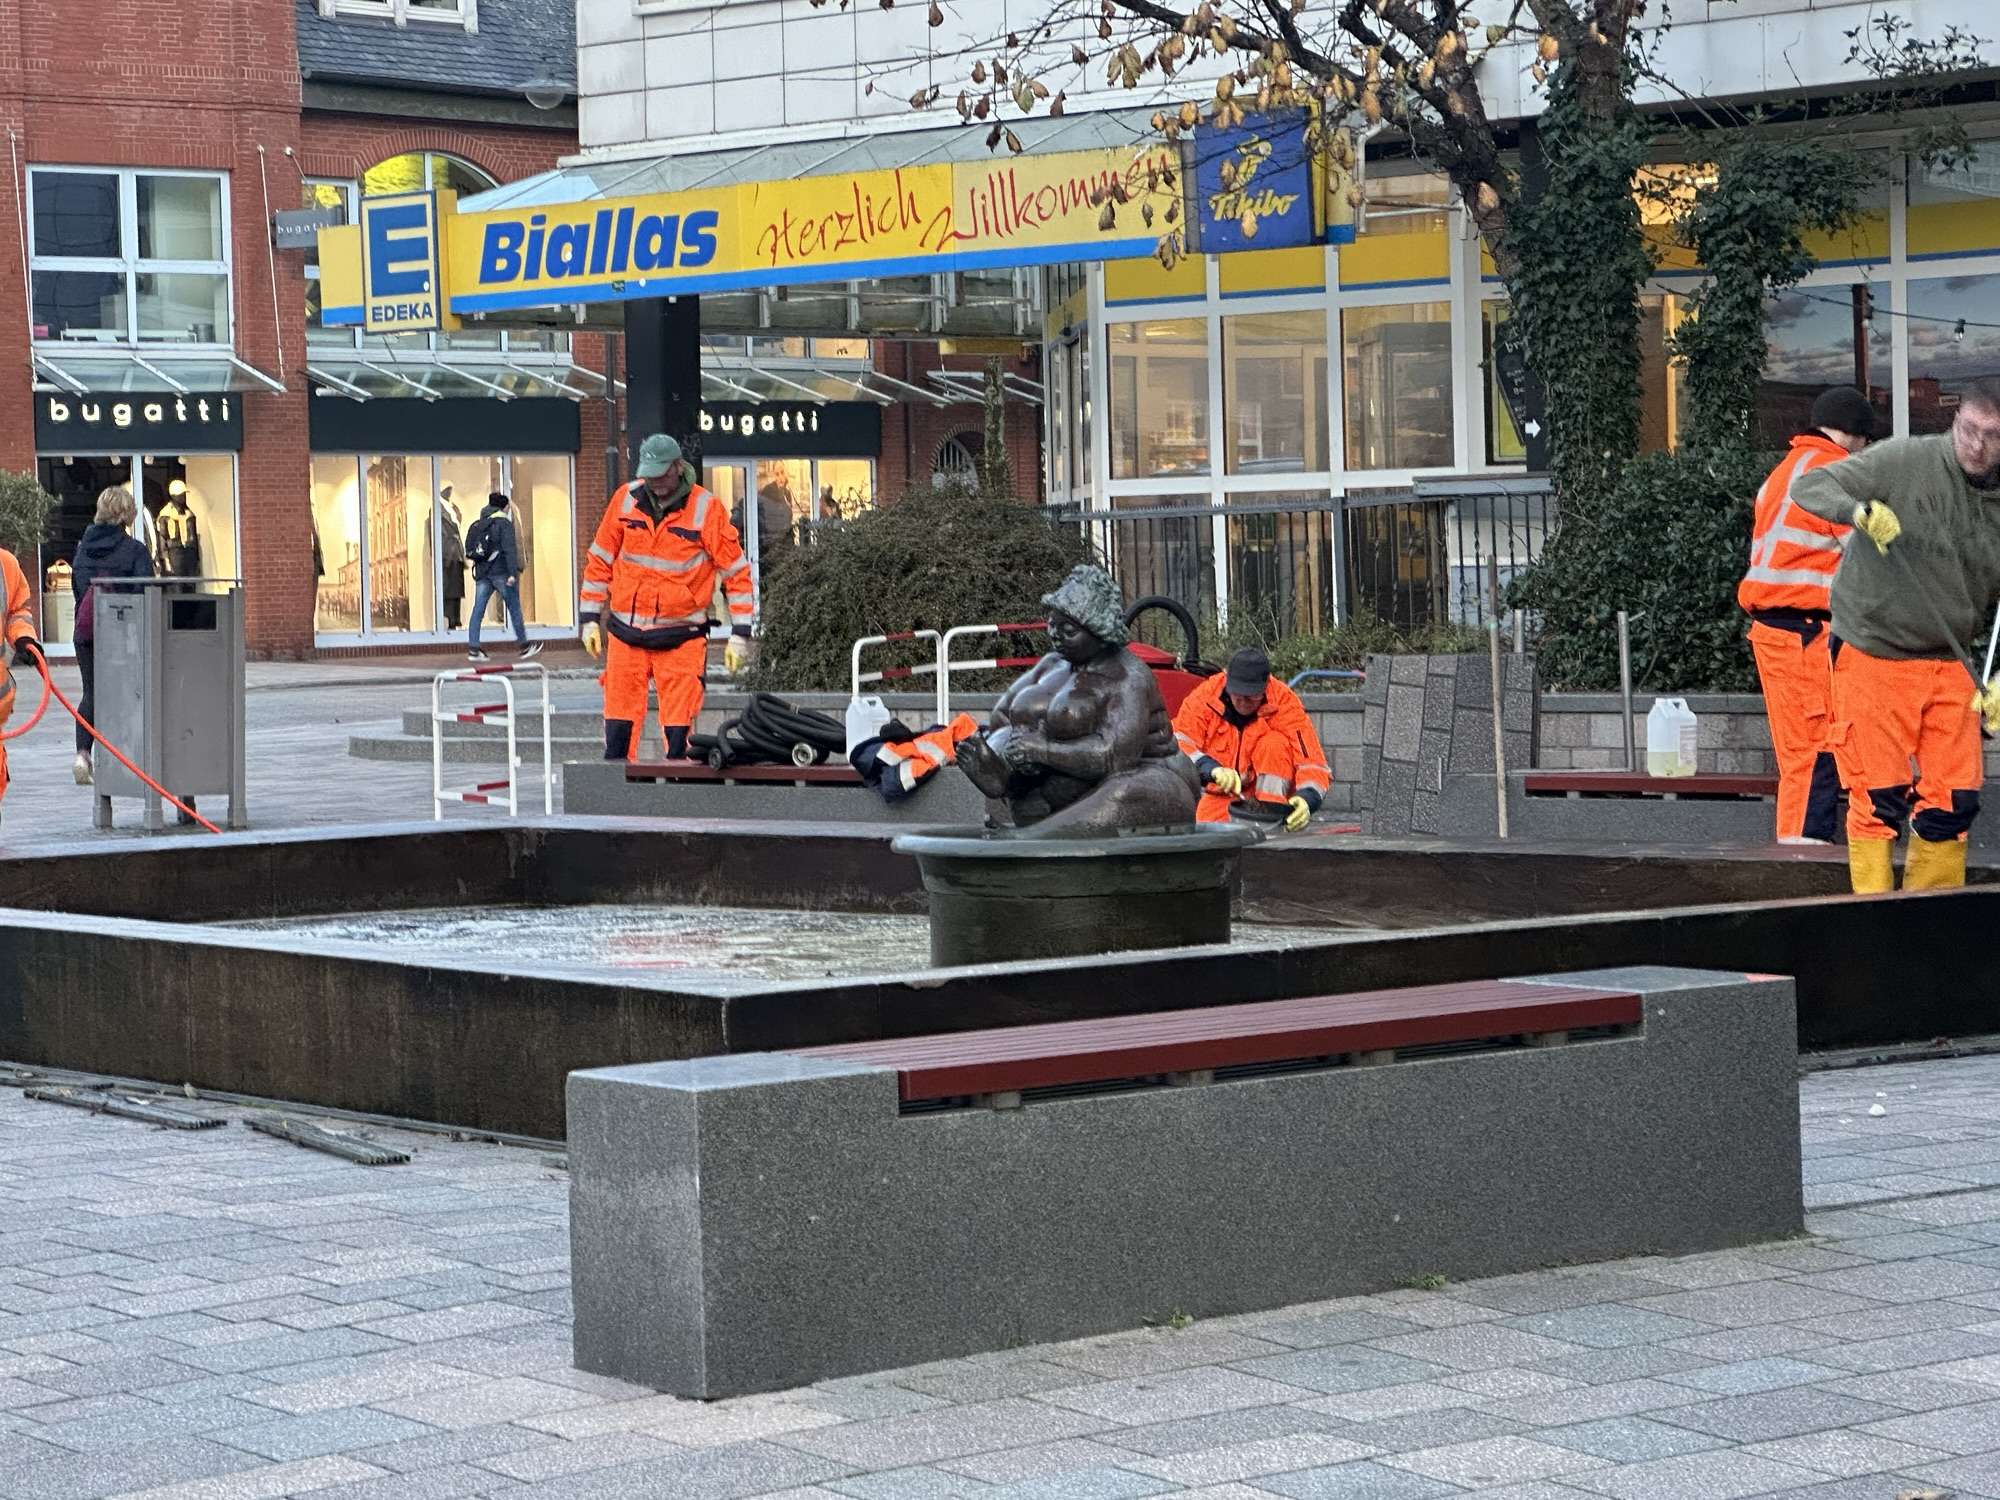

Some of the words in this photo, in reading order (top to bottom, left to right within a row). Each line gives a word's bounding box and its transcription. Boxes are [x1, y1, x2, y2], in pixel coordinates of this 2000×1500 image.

[757, 168, 921, 267] Herzlich
[1208, 188, 1301, 222] Thibo
[367, 203, 431, 298] E
[478, 206, 720, 285] Biallas
[371, 301, 434, 323] EDEKA
[49, 397, 230, 427] bugatti
[700, 409, 819, 436] bugatti
